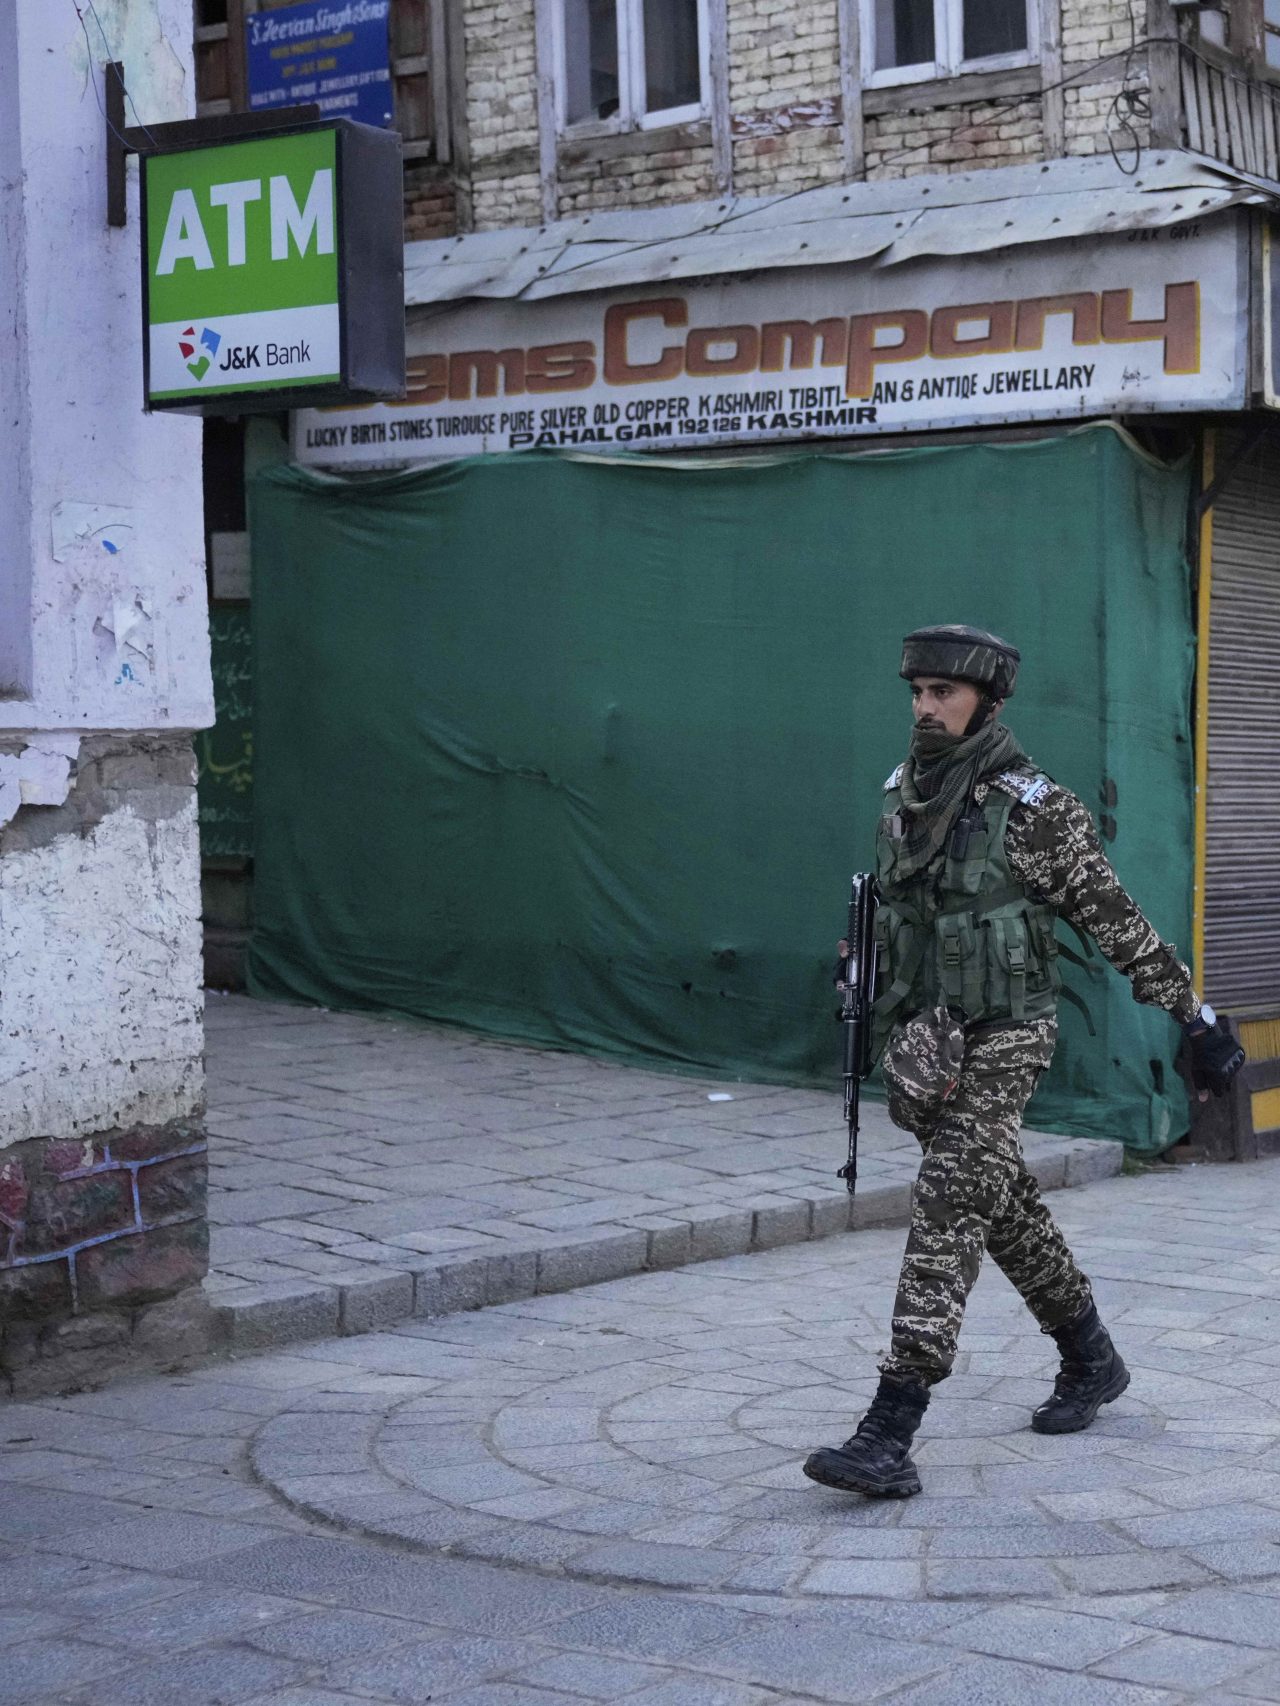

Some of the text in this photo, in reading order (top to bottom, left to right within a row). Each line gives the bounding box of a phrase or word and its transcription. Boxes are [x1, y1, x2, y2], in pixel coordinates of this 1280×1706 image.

[155, 168, 335, 277] ATM
[219, 340, 311, 372] J&K Bank
[306, 426, 347, 449] LUCKY
[351, 422, 386, 445] BIRTH
[389, 418, 433, 442] STONES
[500, 410, 534, 434] PURE
[540, 406, 587, 431] SILVER
[593, 403, 620, 426] OLD
[625, 397, 689, 422] COPPER
[698, 389, 783, 417] KASHMIRI
[901, 379, 914, 403] &
[982, 364, 1096, 396] JEWELLARY
[748, 406, 878, 431] KASHMIR
